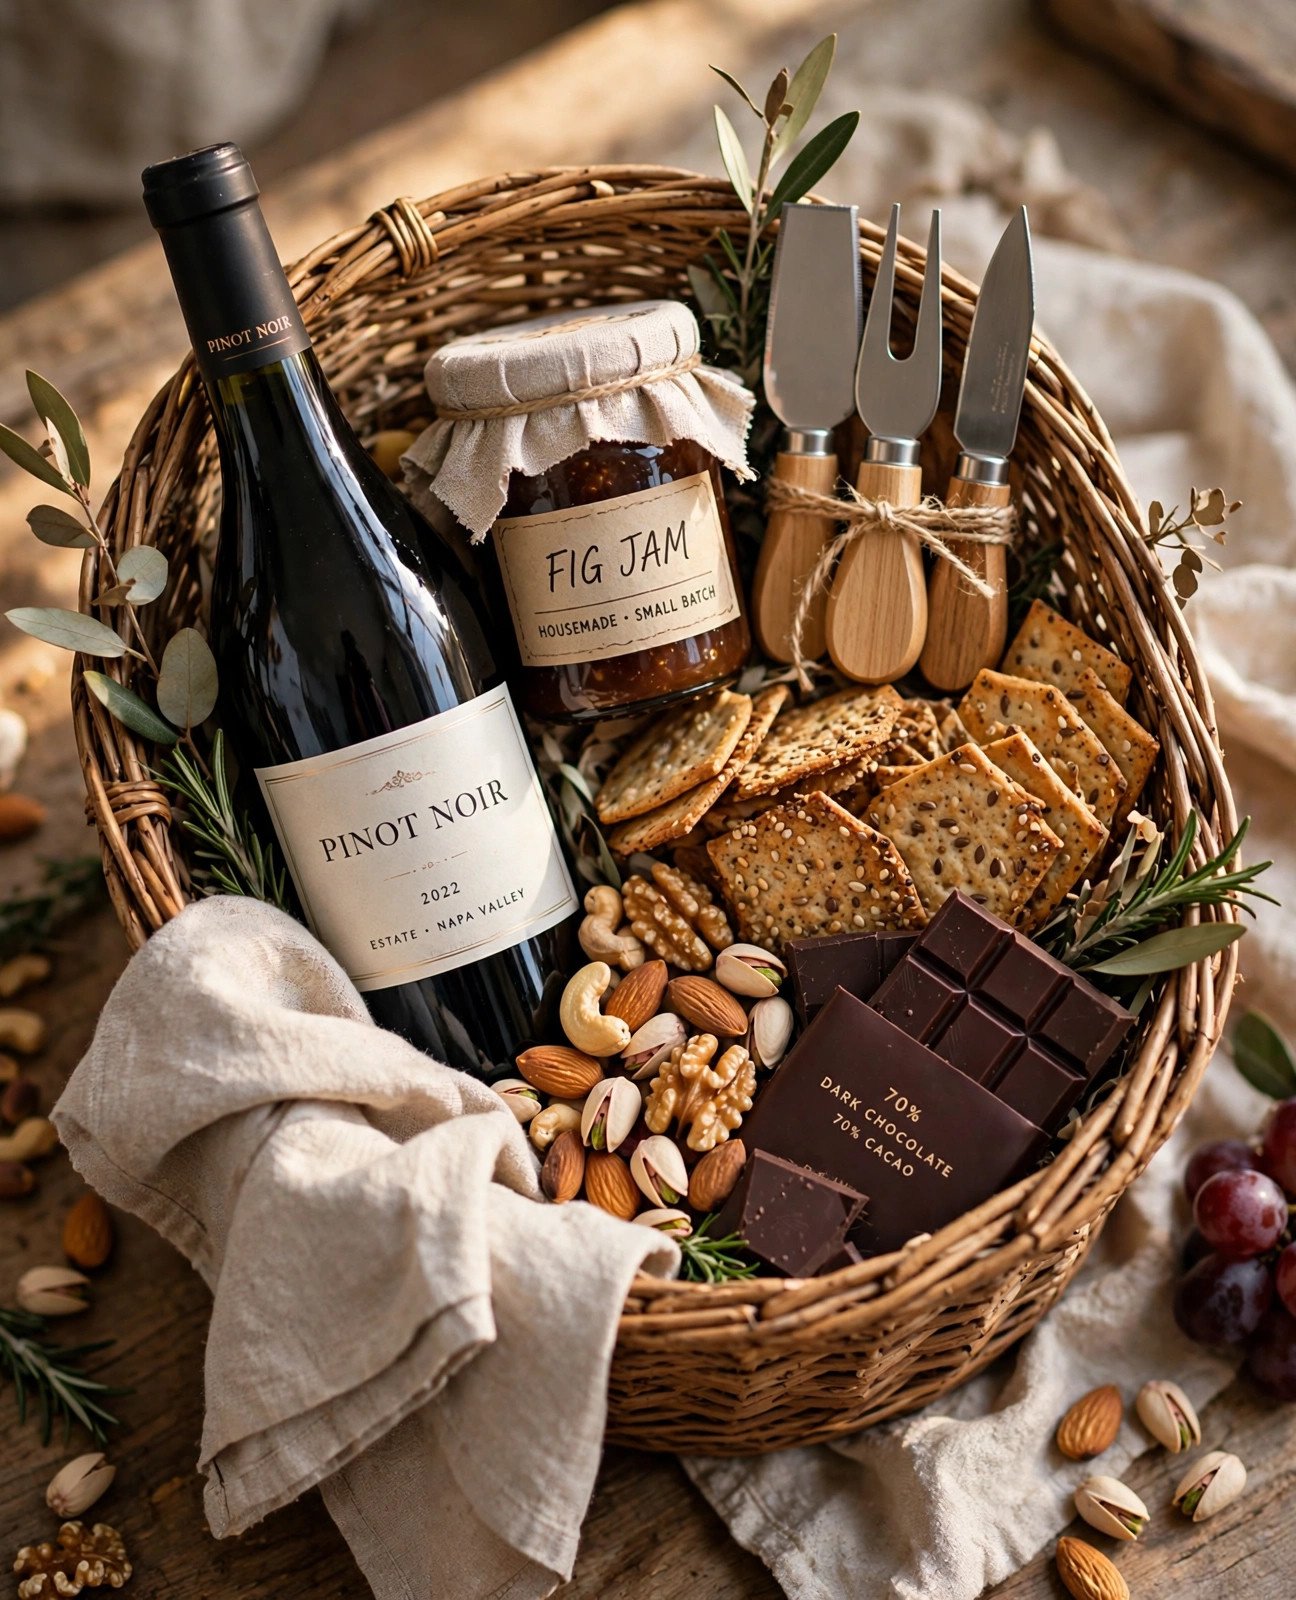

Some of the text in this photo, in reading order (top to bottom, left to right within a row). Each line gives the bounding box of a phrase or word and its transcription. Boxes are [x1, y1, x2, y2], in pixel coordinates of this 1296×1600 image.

[207, 315, 292, 353] PINOT NOIR
[545, 520, 689, 593] FIG JAM
[538, 585, 716, 638] HOUSEMADE SMALL BATCH
[319, 779, 508, 862] PINOT NOIR
[370, 887, 525, 950] ESTATE NAPA VALLEY
[420, 881, 461, 905] 2022
[820, 1076, 862, 1111] DARK
[864, 1108, 953, 1178] CHOCOLATE
[884, 1087, 922, 1122] 70%
[832, 1113, 914, 1177] 70% CACAO
